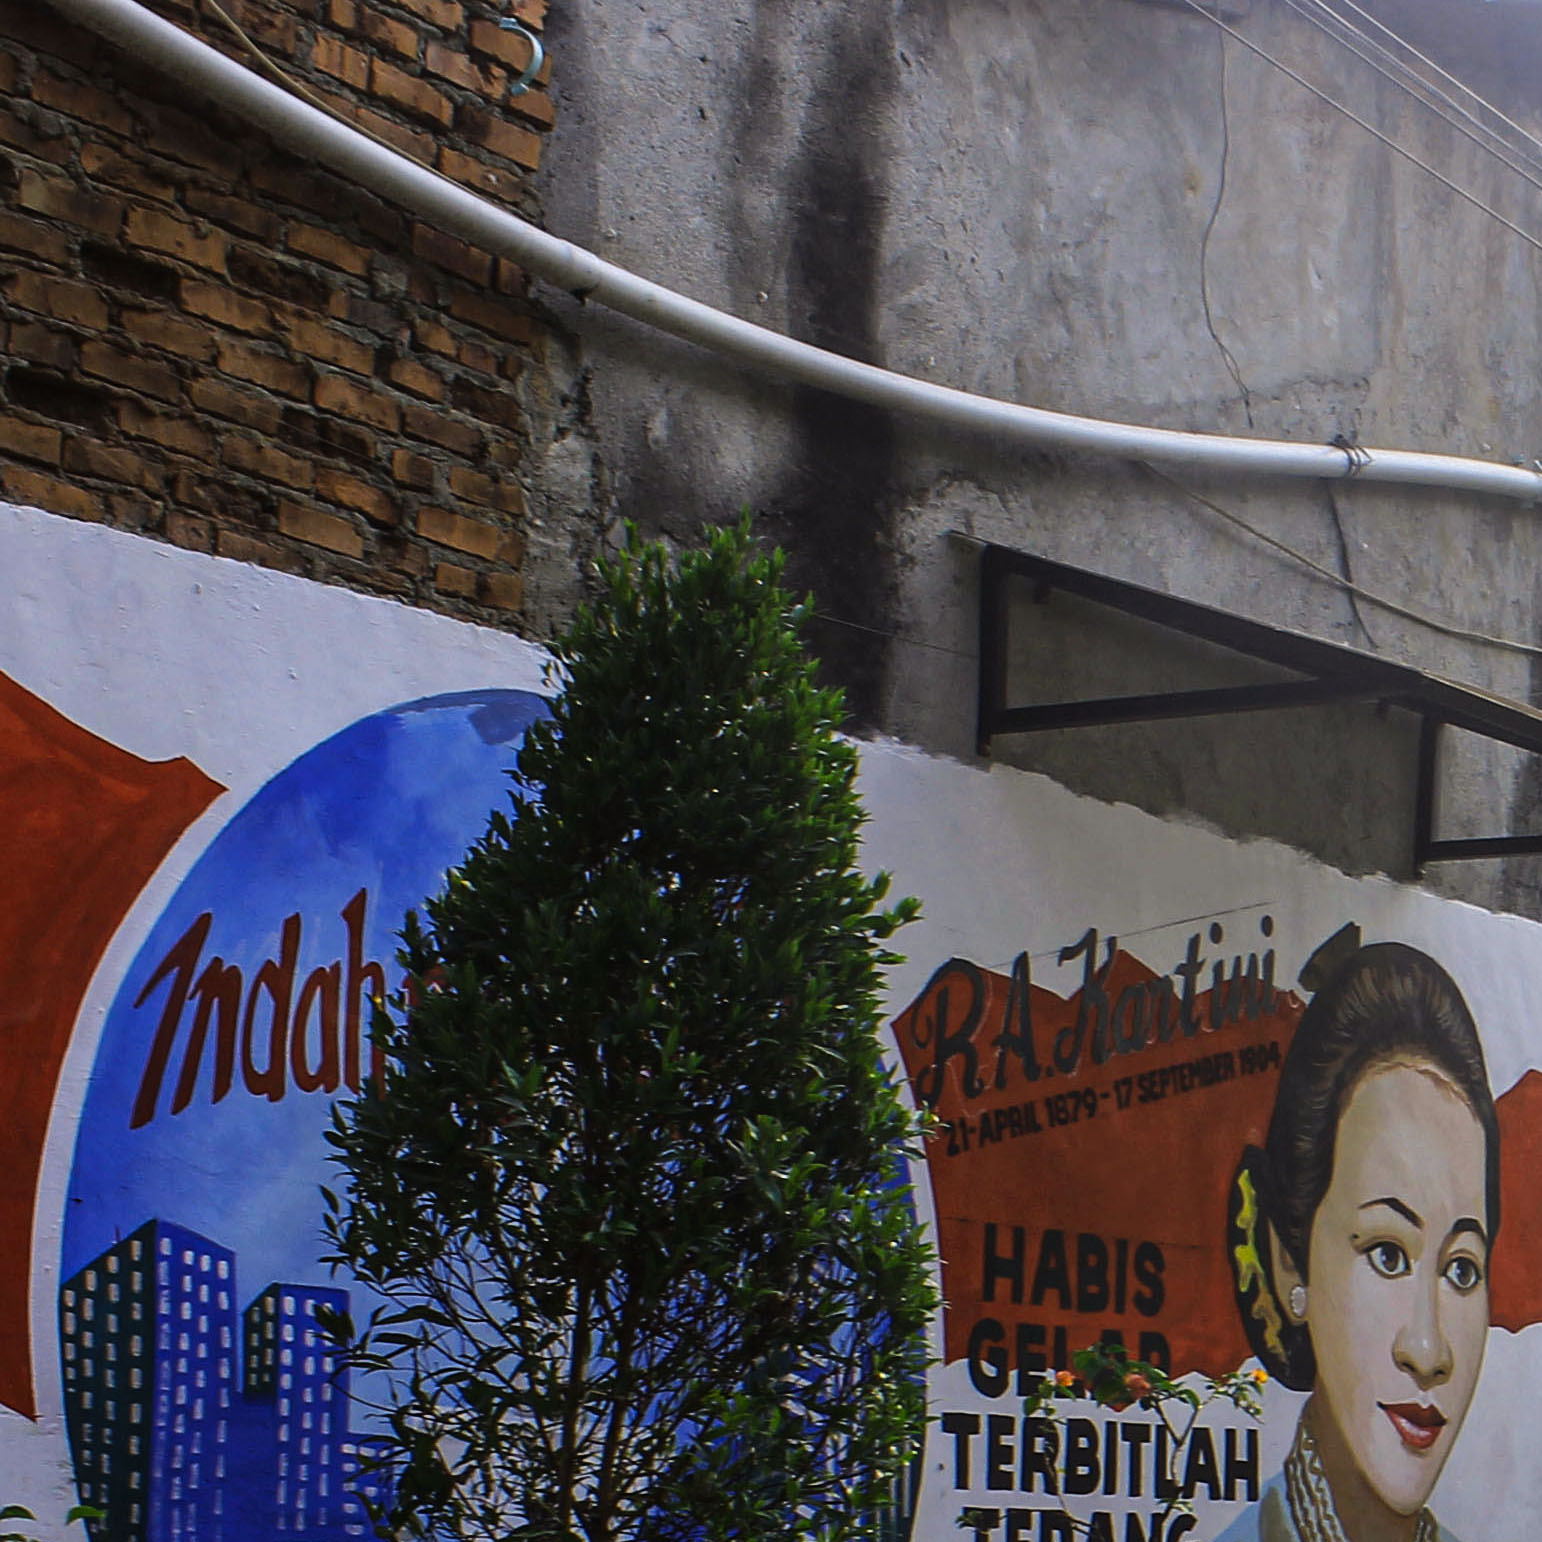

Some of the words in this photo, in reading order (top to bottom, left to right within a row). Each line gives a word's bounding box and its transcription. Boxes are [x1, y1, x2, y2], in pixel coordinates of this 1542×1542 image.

[1045, 1087, 1098, 1129] 1879
[1114, 1077, 1132, 1111] 17
[1138, 1051, 1236, 1101] SEPTEMBER
[984, 1222, 1166, 1317] HABIS
[942, 1412, 1260, 1502] TERBITLAH
